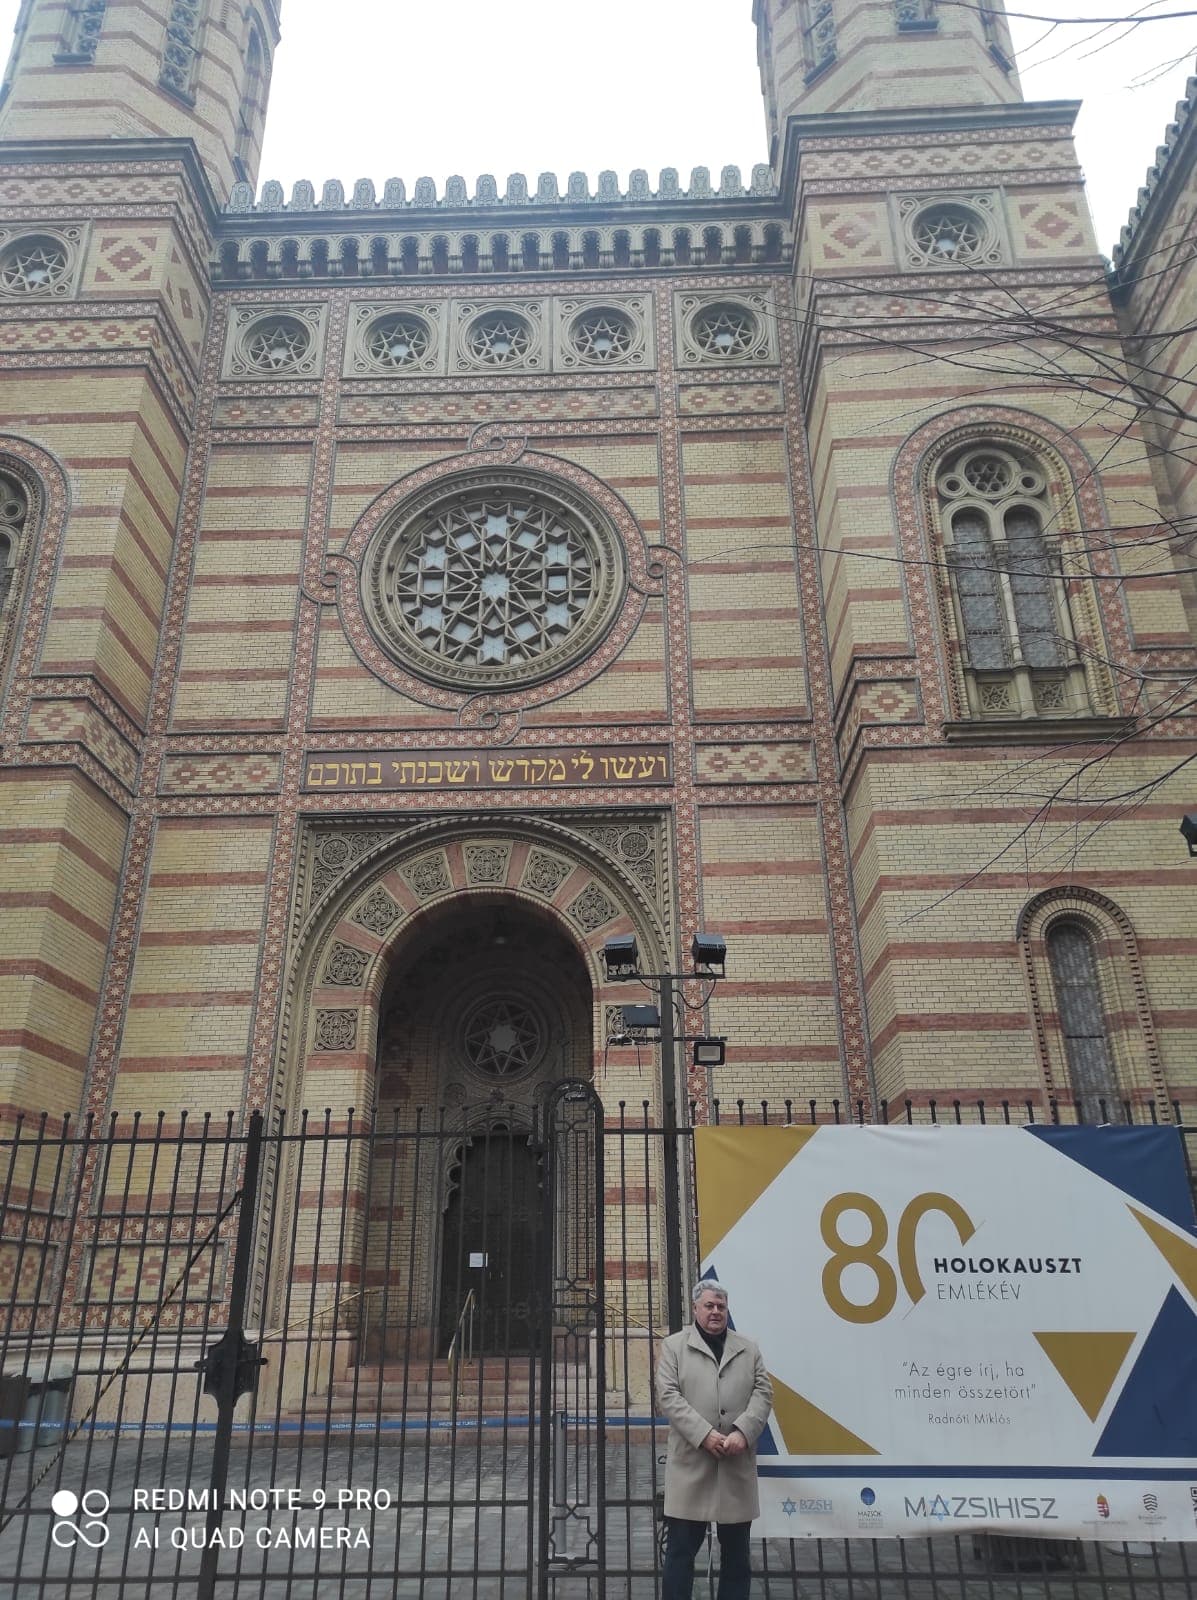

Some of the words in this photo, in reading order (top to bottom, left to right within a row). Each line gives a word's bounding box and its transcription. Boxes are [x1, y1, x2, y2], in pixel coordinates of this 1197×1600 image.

[307, 762, 382, 785] בתוכם
[391, 760, 480, 783] ושכנתי
[488, 759, 566, 784] מקדש
[571, 750, 594, 780] לי
[600, 756, 666, 780] ועשו
[820, 1192, 976, 1324] 80
[933, 1257, 1082, 1274] HOLOKAUSZT
[937, 1281, 1021, 1300] EMLÉKÉV
[936, 1363, 972, 1381] égre
[1005, 1360, 1024, 1377] ha
[895, 1382, 951, 1399] minden
[928, 1411, 970, 1424] Radnóti
[974, 1410, 1011, 1424] Miklós
[799, 1499, 833, 1511] BZSH
[904, 1493, 1060, 1520] MAZSIHISZ
